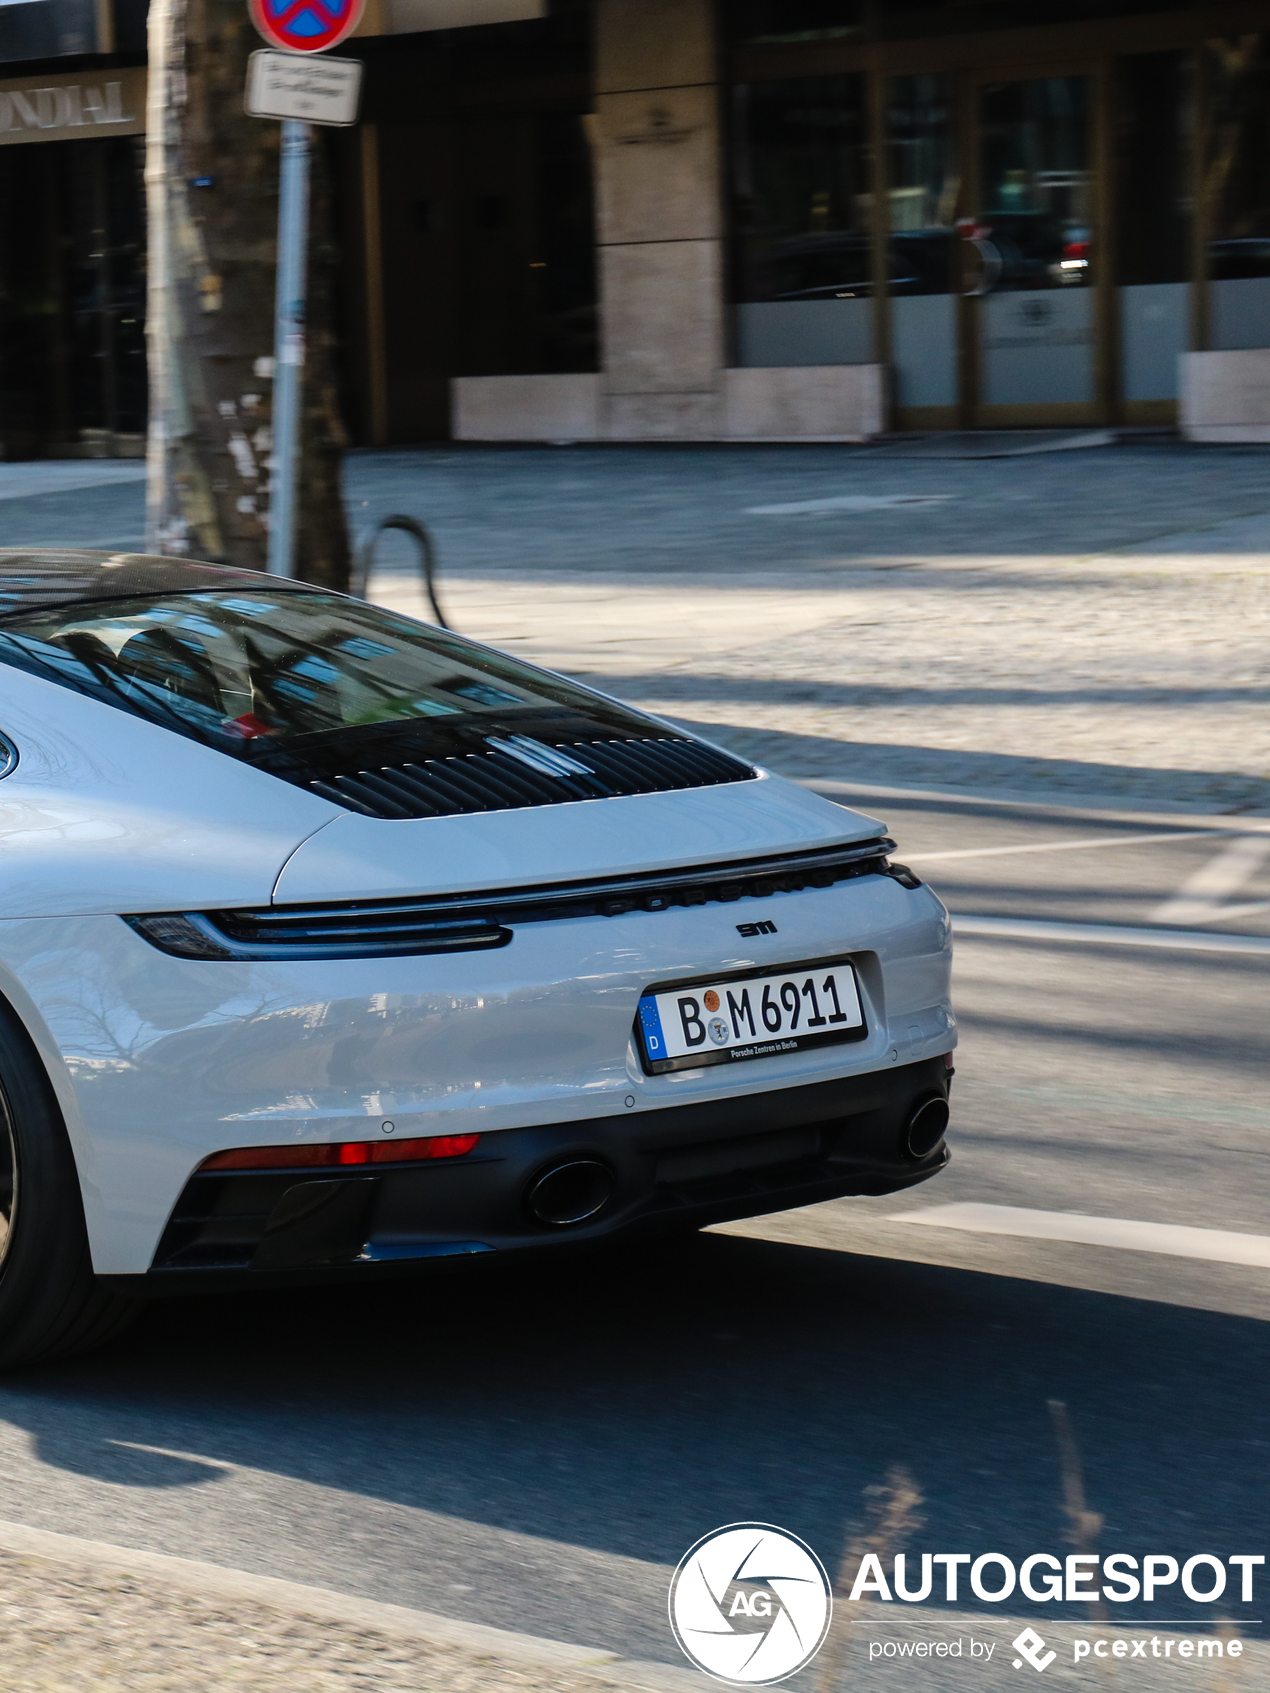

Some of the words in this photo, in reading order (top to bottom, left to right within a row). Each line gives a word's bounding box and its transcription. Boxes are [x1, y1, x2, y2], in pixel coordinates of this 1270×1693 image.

[601, 872, 836, 917] PORSCHE
[735, 919, 778, 938] 911
[677, 996, 707, 1047] B
[648, 1035, 660, 1051] D
[731, 1047, 754, 1058] Porsche
[754, 1044, 775, 1054] Zentren
[775, 1042, 782, 1051] in
[781, 1039, 798, 1050] Berlin
